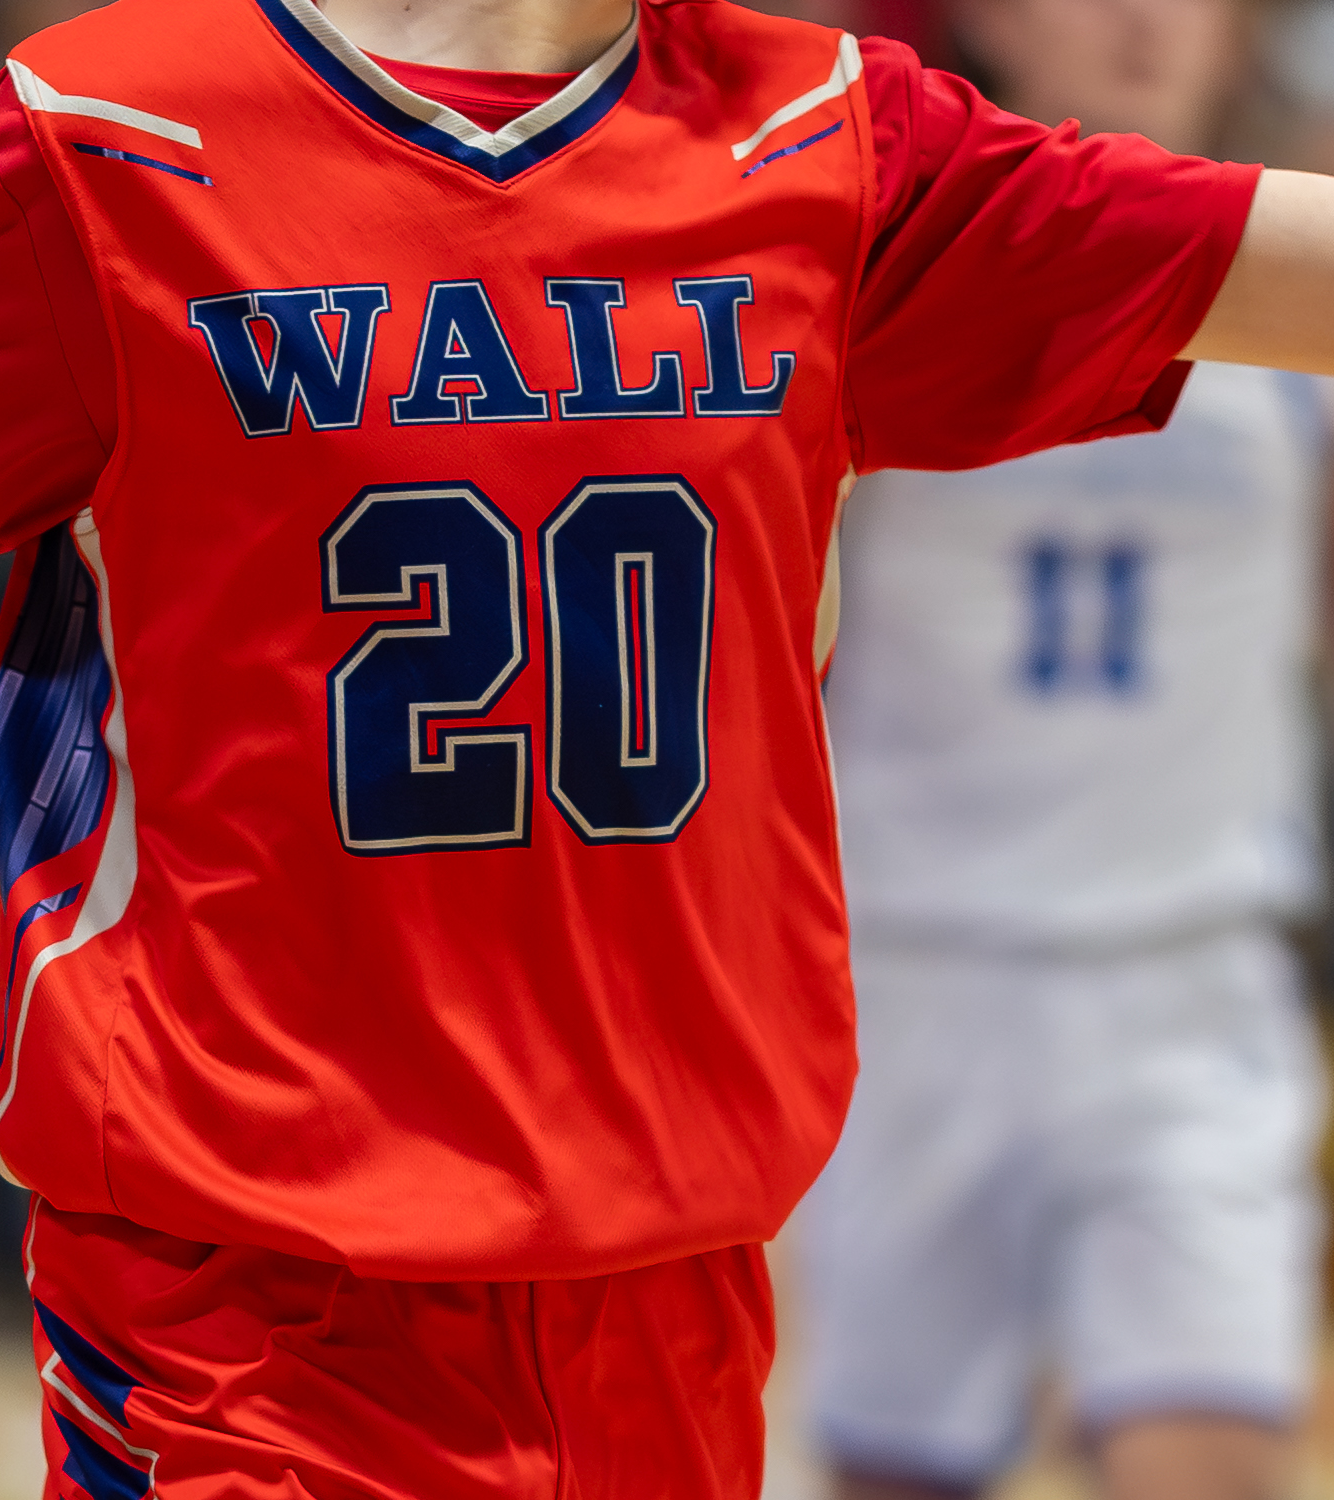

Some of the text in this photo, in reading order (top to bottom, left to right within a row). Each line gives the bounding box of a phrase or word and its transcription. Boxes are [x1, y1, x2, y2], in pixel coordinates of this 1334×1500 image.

[188, 274, 796, 438] WALL
[319, 474, 718, 857] 20
[1011, 532, 1157, 700] 11
